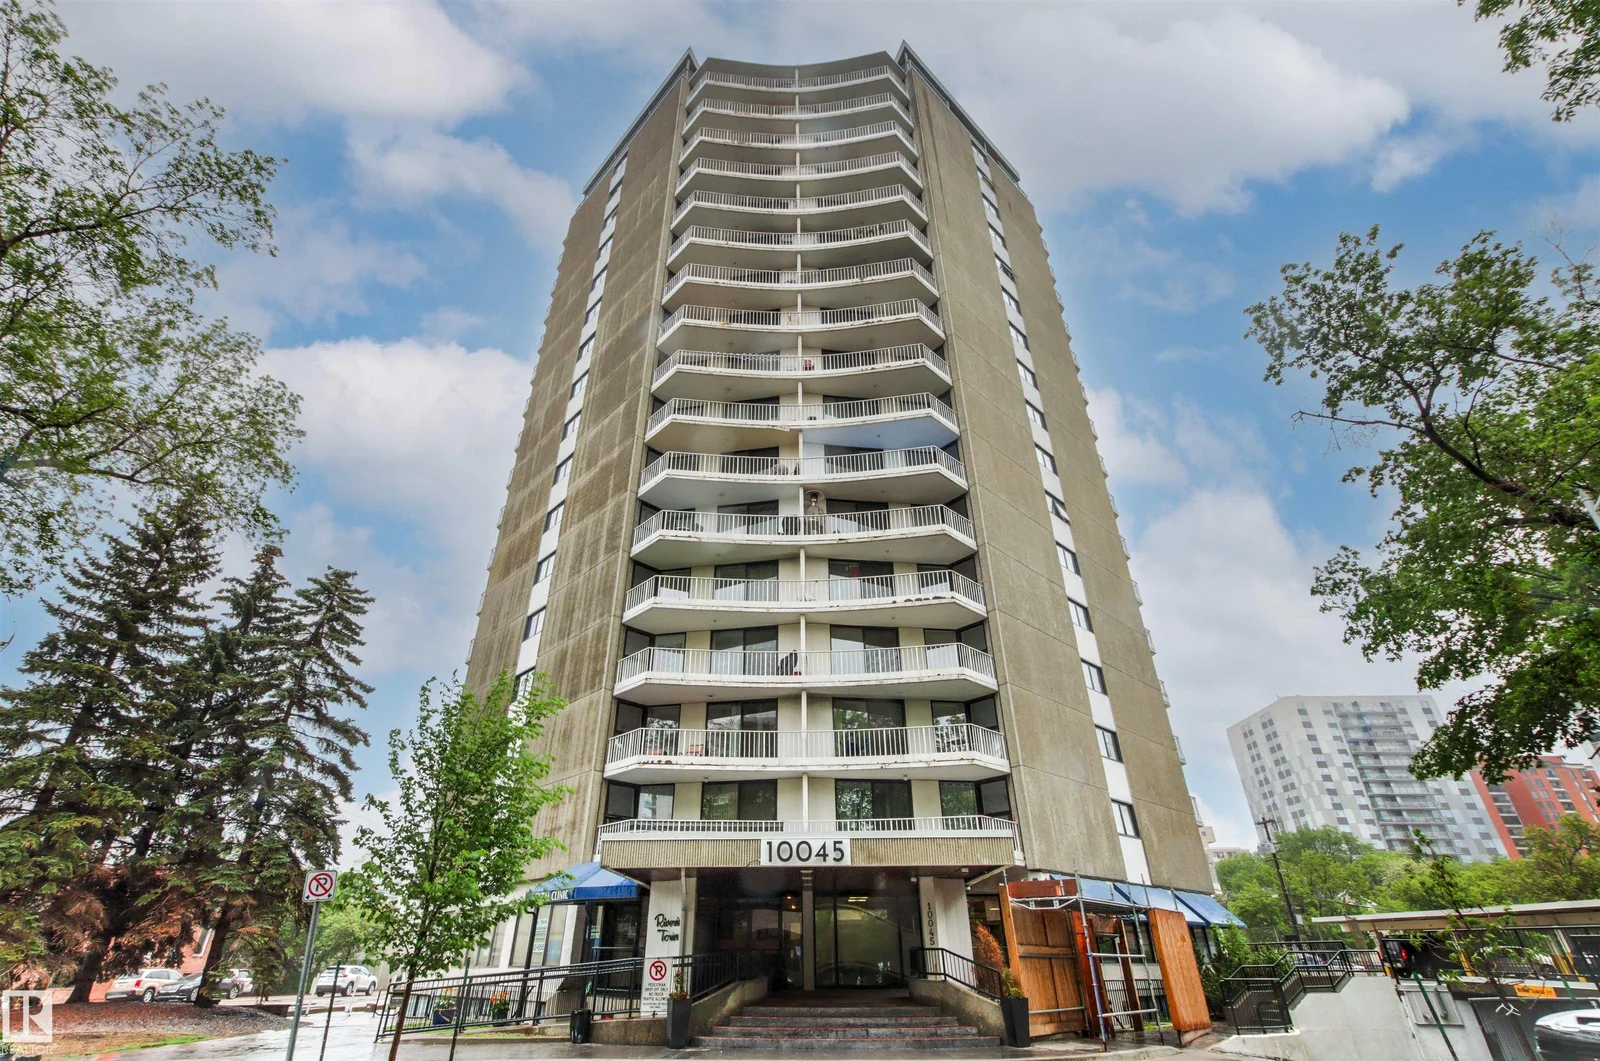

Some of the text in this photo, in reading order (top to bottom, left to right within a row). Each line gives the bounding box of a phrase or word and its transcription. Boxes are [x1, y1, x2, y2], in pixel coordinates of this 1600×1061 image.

[766, 840, 845, 862] 10045
[551, 889, 569, 900] CLINIC
[927, 902, 935, 945] 10045
